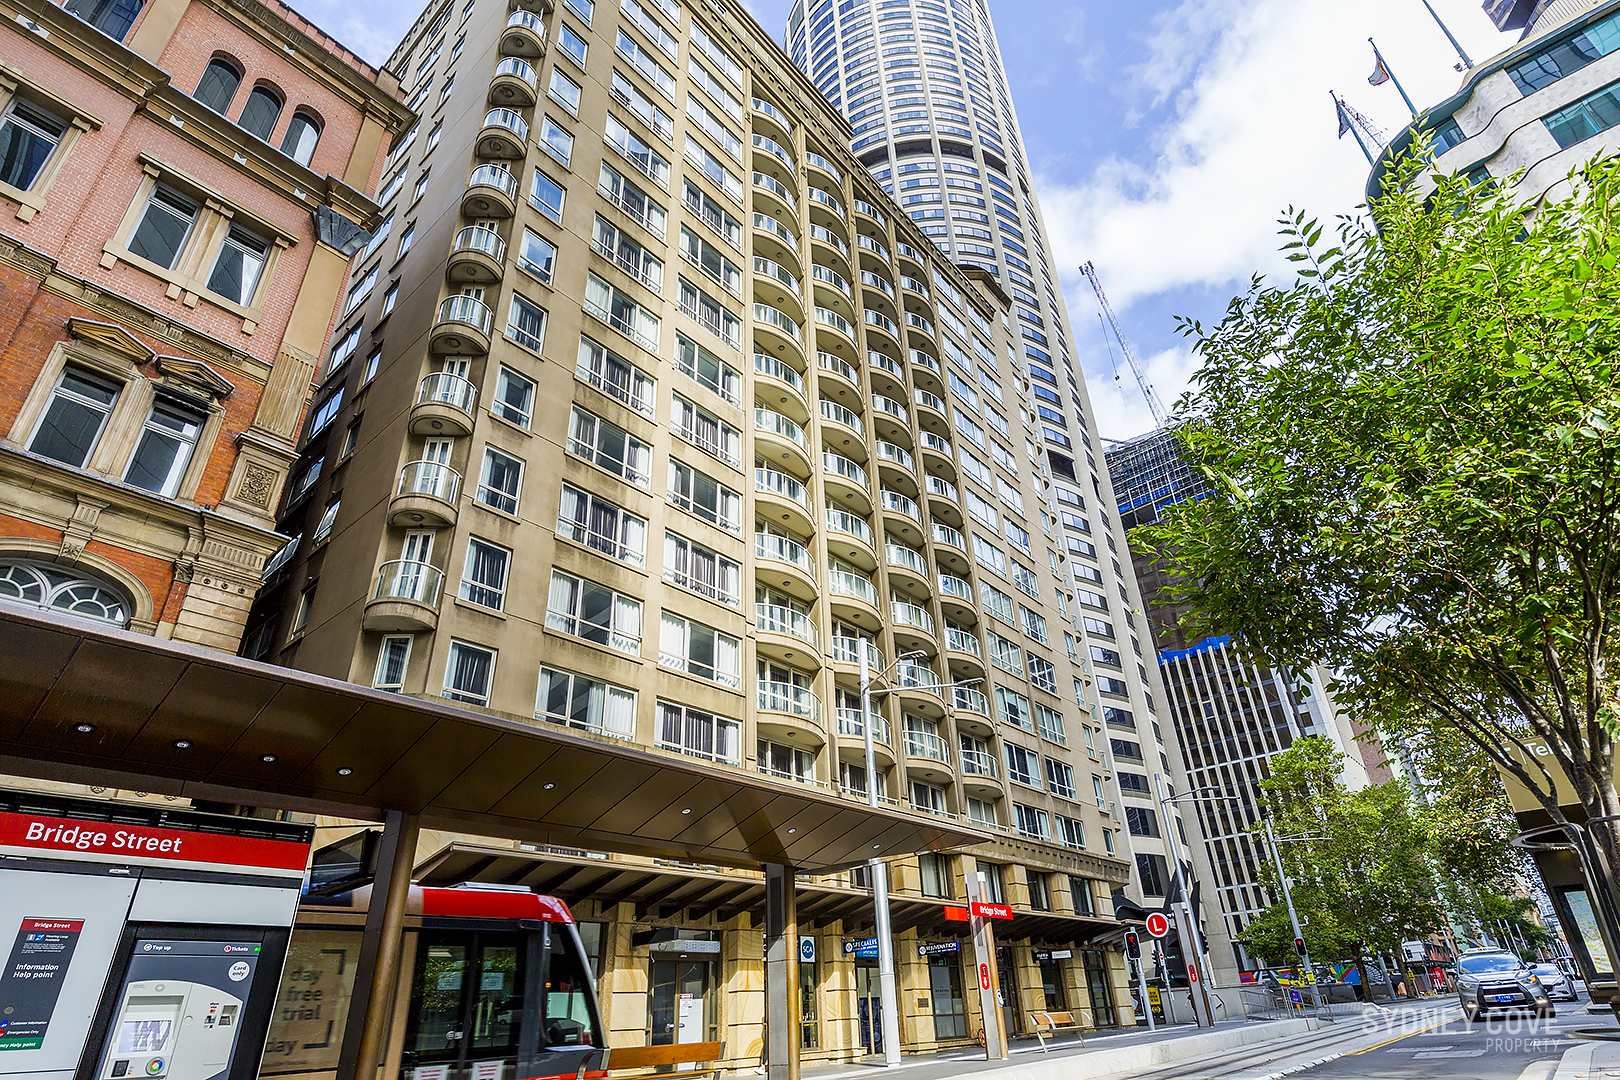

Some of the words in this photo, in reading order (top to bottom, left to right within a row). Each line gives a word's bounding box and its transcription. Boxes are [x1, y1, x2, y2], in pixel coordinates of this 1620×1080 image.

[26, 822, 107, 849] Bridge
[112, 831, 182, 853] Street
[980, 906, 993, 916] Bridge
[1152, 918, 1163, 932] L
[803, 945, 813, 953] SCA
[286, 985, 323, 1001] free
